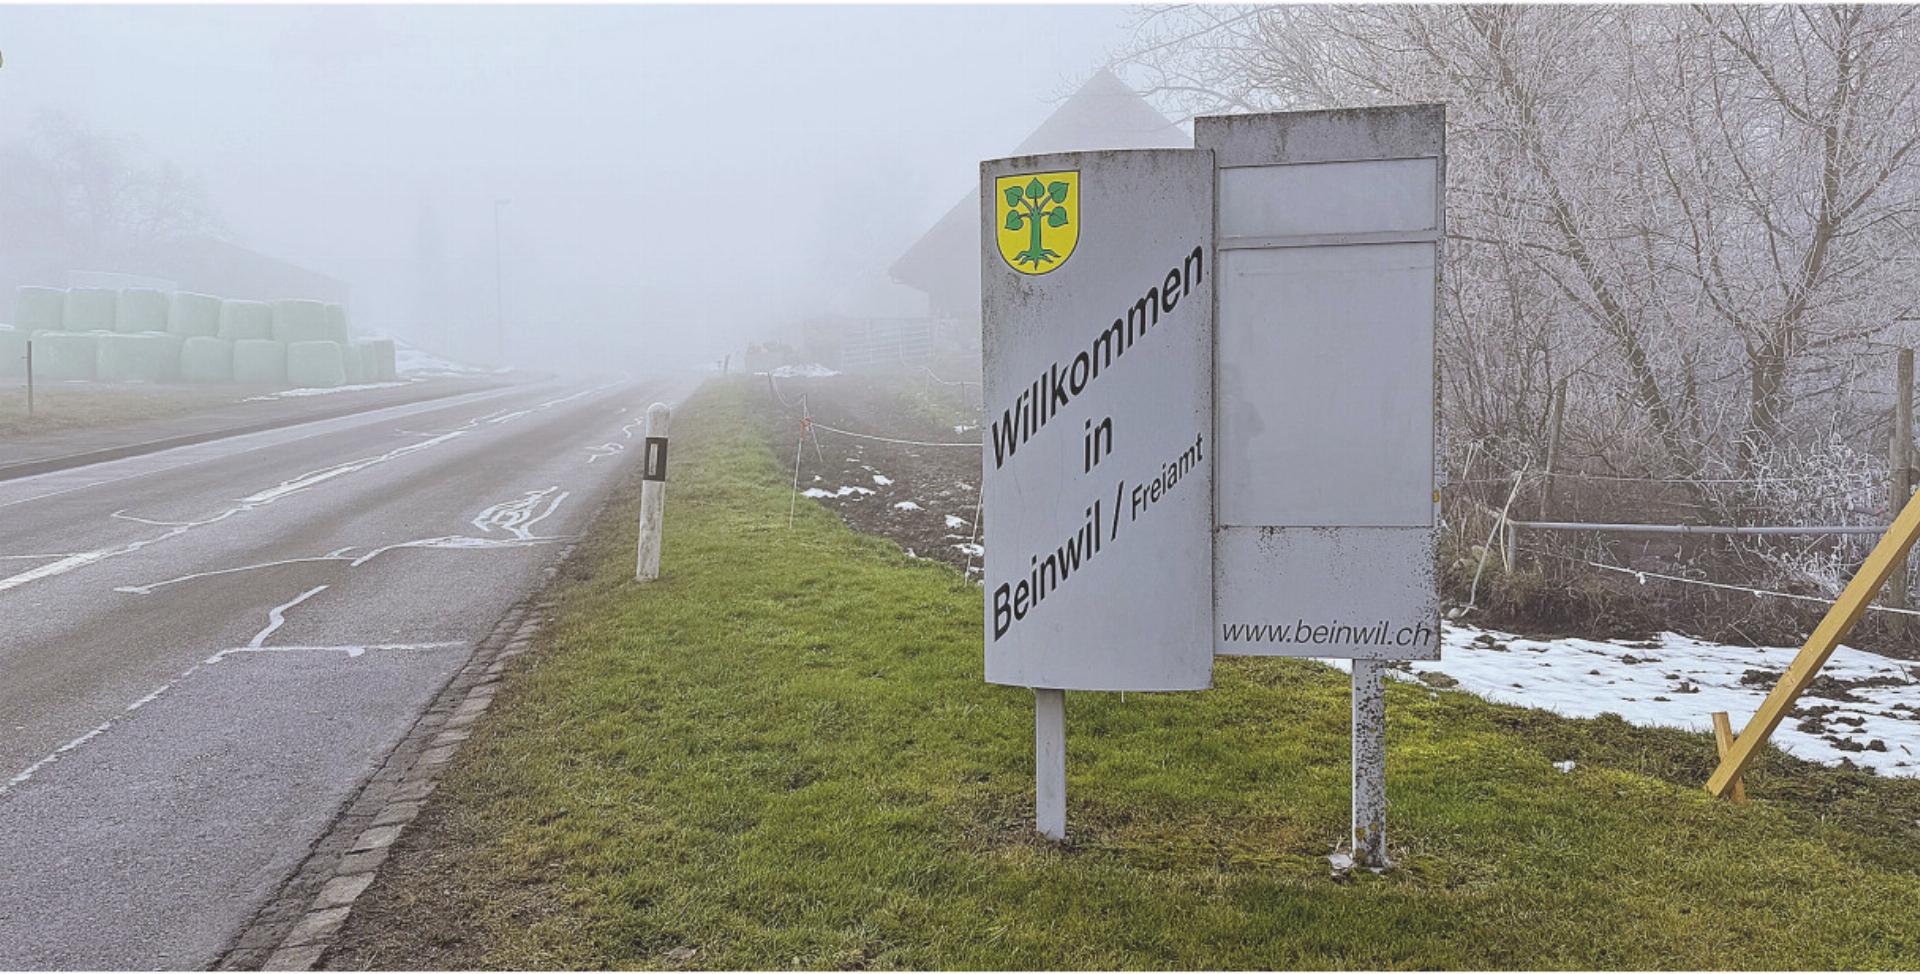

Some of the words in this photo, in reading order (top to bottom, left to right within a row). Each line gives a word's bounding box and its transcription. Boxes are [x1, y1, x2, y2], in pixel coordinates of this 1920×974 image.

[991, 245, 1203, 470] Willkommen
[1084, 416, 1112, 474] in
[993, 500, 1101, 642] Beinwil
[1110, 480, 1124, 541] /
[1132, 434, 1203, 522] Freiamt
[1222, 619, 1433, 647] www.beinwil.ch
